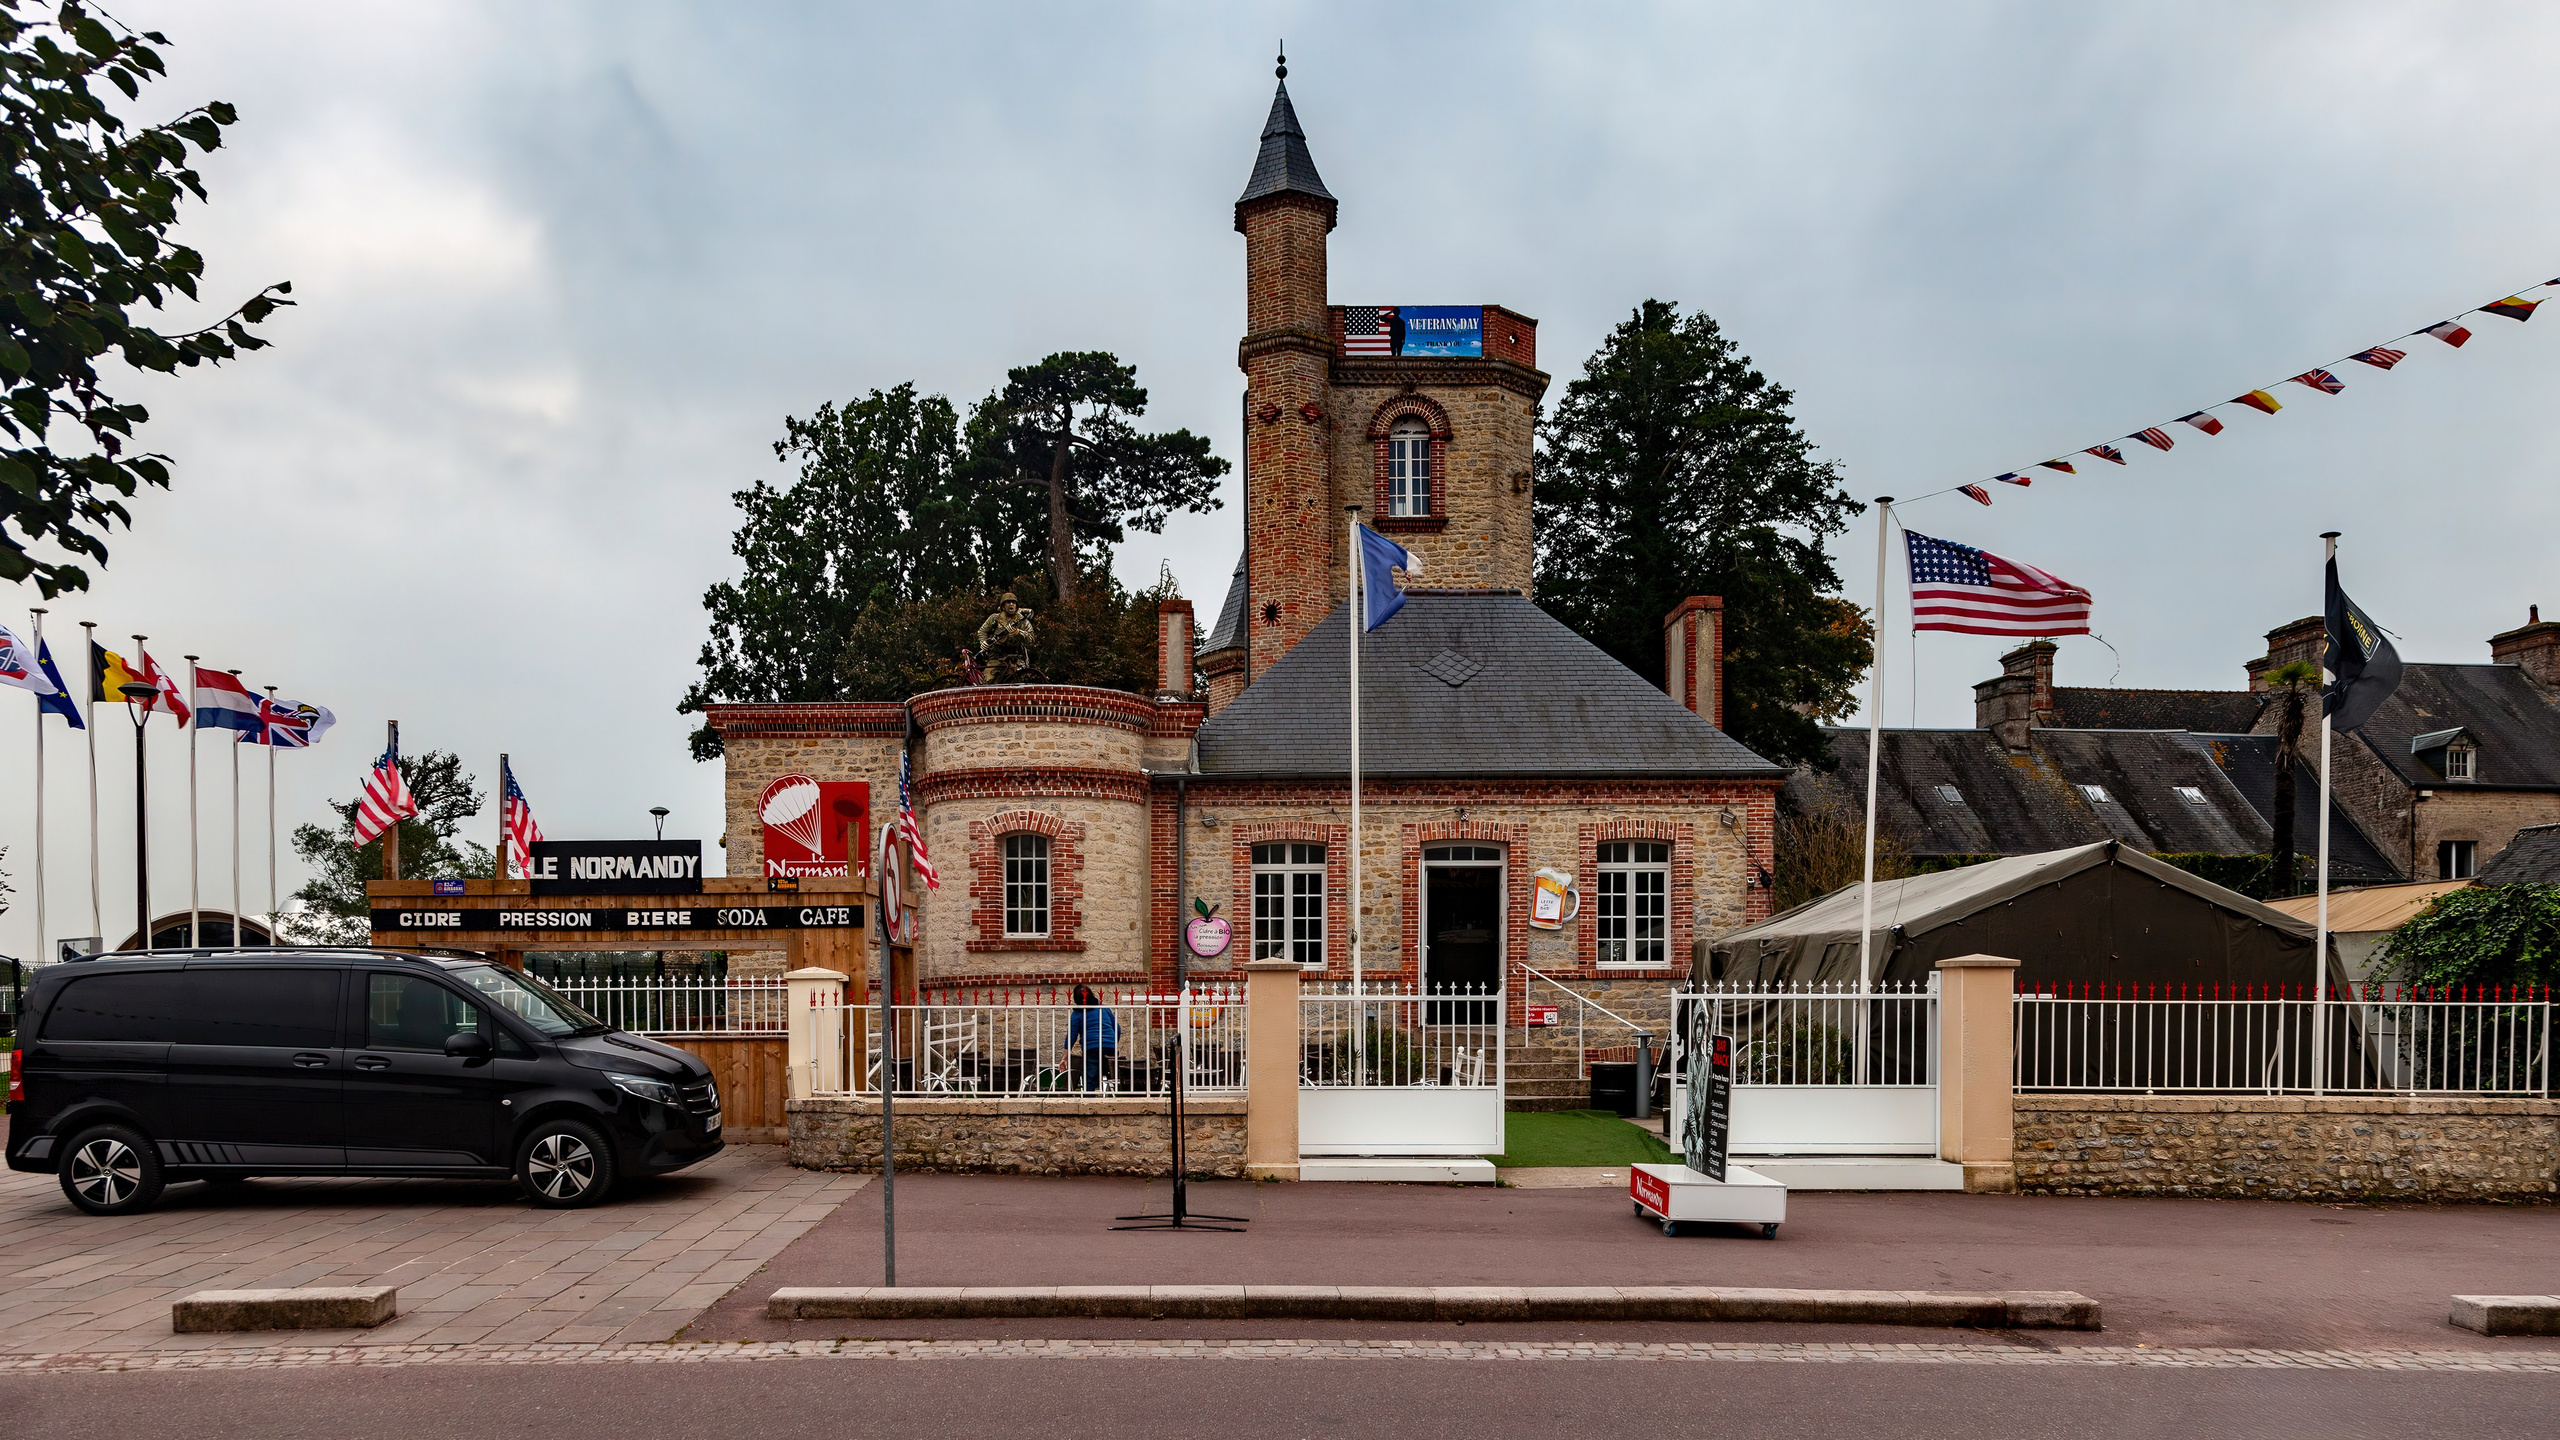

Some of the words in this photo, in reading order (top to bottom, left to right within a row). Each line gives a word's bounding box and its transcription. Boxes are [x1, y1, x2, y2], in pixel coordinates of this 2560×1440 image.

[1409, 318, 1457, 331] VETERANS
[1460, 318, 1479, 330] DAY
[811, 853, 826, 864] Le
[529, 856, 558, 880] LE
[570, 855, 699, 880] NORMANDY
[399, 912, 462, 927] CIDRE
[499, 912, 592, 927] PRESSION
[626, 911, 692, 926] BIERE
[717, 908, 768, 926] SODA
[799, 907, 850, 925] CAFE
[1716, 1039, 1727, 1052] BAR
[1712, 1052, 1730, 1067] SNACK
[1636, 1175, 1663, 1212] Normandy
